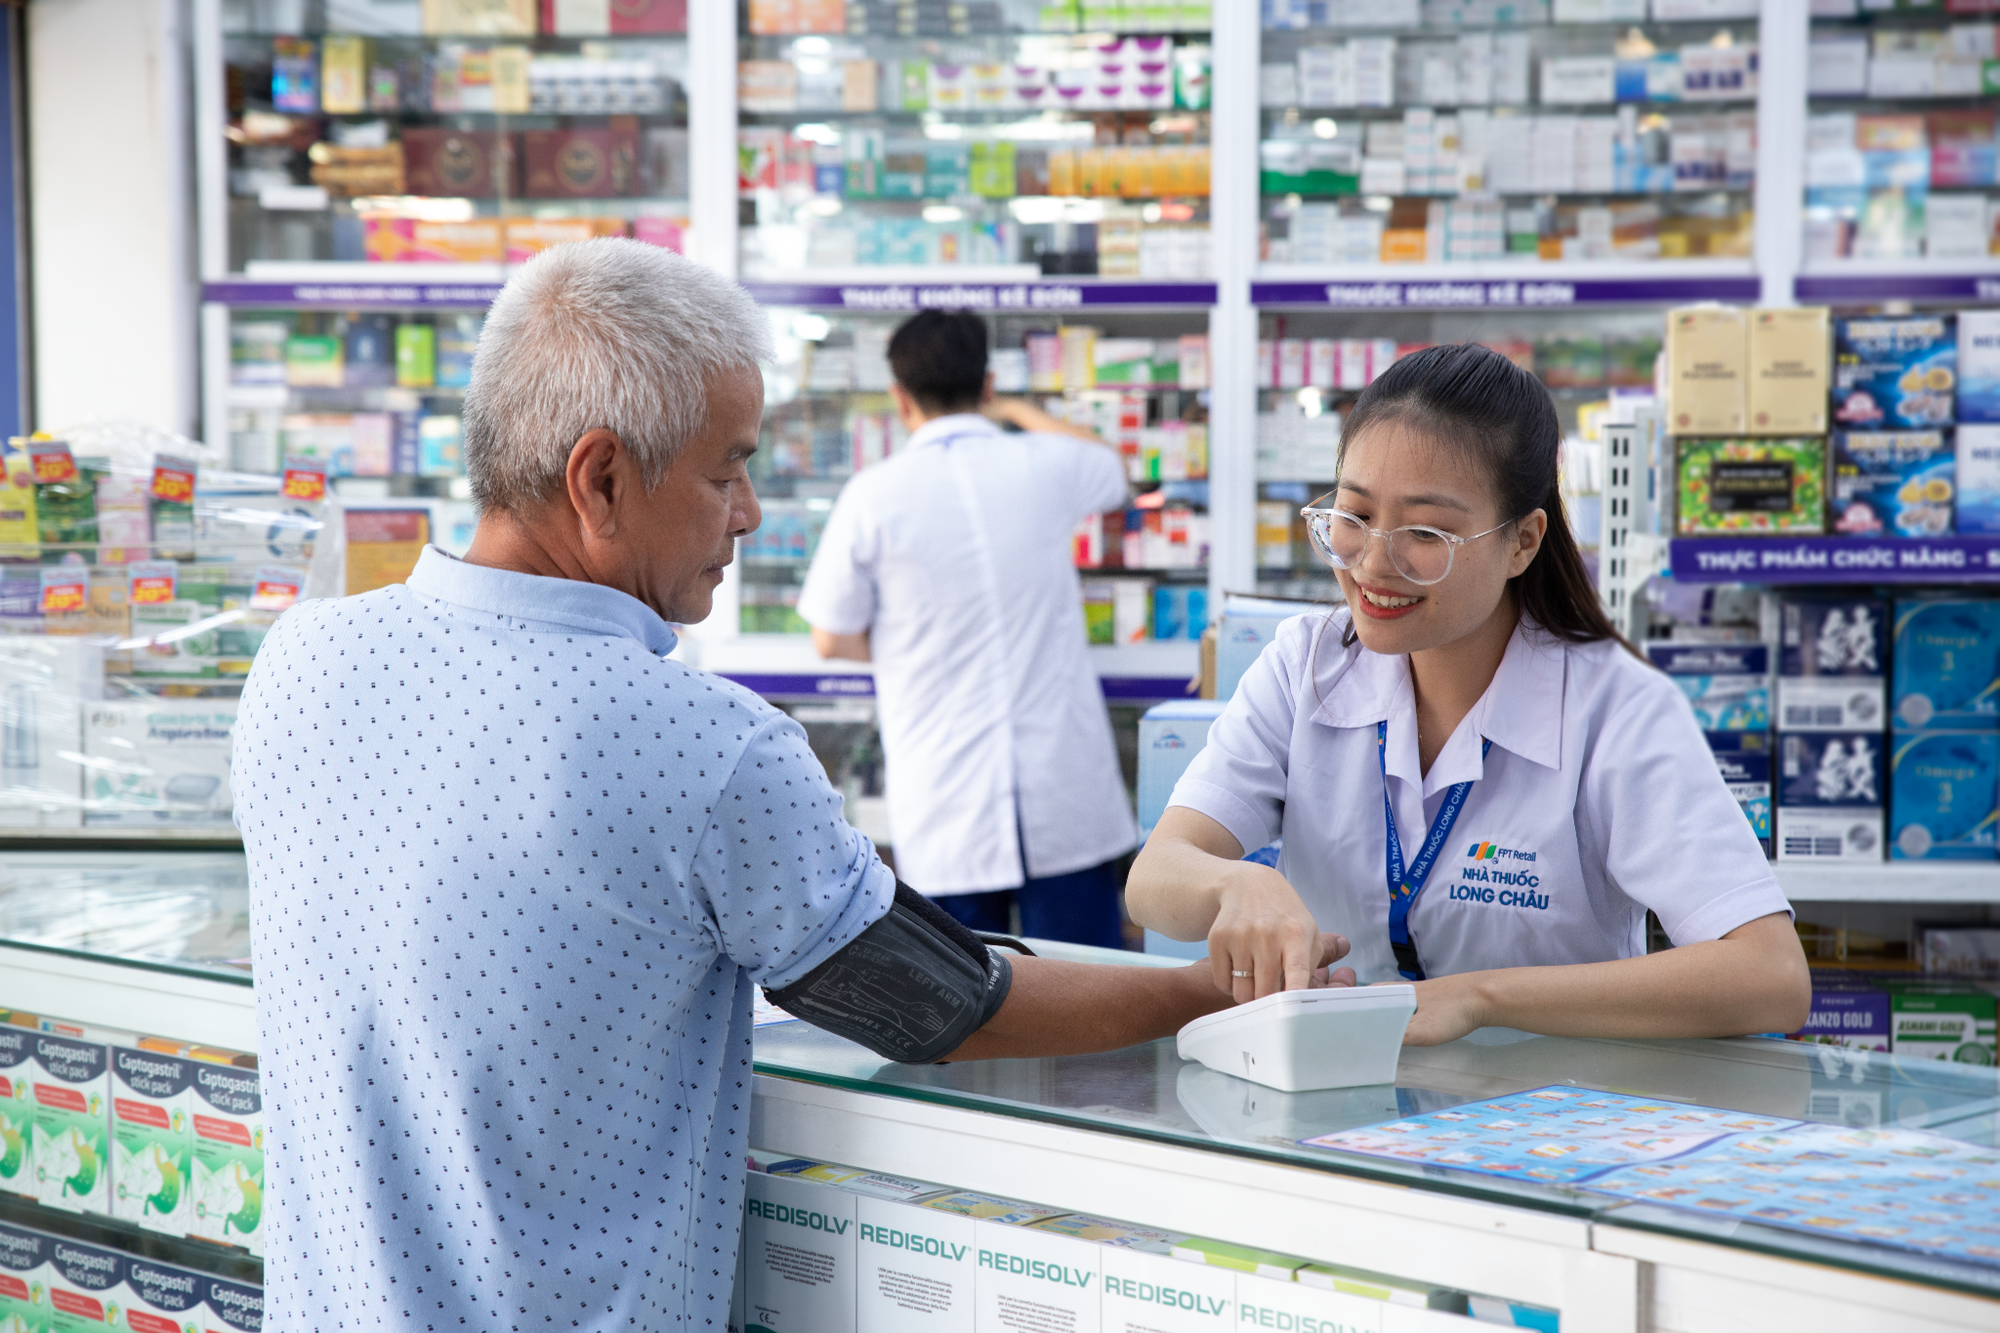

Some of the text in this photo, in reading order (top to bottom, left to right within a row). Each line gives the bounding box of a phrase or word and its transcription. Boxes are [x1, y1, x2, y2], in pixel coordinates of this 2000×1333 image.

[918, 284, 995, 307] KHÔNG
[1326, 283, 1402, 305] THUỐC
[1406, 282, 1486, 305] KHÔNG
[1762, 545, 1827, 568] PHẨM
[1833, 547, 1894, 568] CHỨC
[1902, 547, 1966, 568] NĂNG
[1413, 858, 1428, 879] NHÀ
[1424, 830, 1444, 860] THUỐC
[1438, 804, 1456, 831] LONG
[1498, 848, 1536, 862] FPT Retail
[1393, 864, 1401, 882] NHÀ
[1462, 866, 1540, 888] NHÀ THUỐC
[1450, 884, 1549, 910] LONG CHÂU
[908, 968, 936, 991] LEFT
[936, 988, 962, 1009] ARM
[850, 1014, 882, 1030] INDEX
[1843, 1012, 1873, 1029] GOLD
[37, 1038, 97, 1064] Captogastril
[48, 1062, 89, 1080] stick pack
[118, 1052, 180, 1079] Captogastril
[130, 1074, 172, 1095] stick pack
[210, 1092, 254, 1112] stick pack
[55, 1243, 114, 1273] Captogastril
[65, 1267, 107, 1288] stick pack
[131, 1264, 193, 1294] Captogastril
[142, 1288, 185, 1309] stick pack
[211, 1284, 264, 1312] Captogast
[222, 1308, 244, 1324] stick
